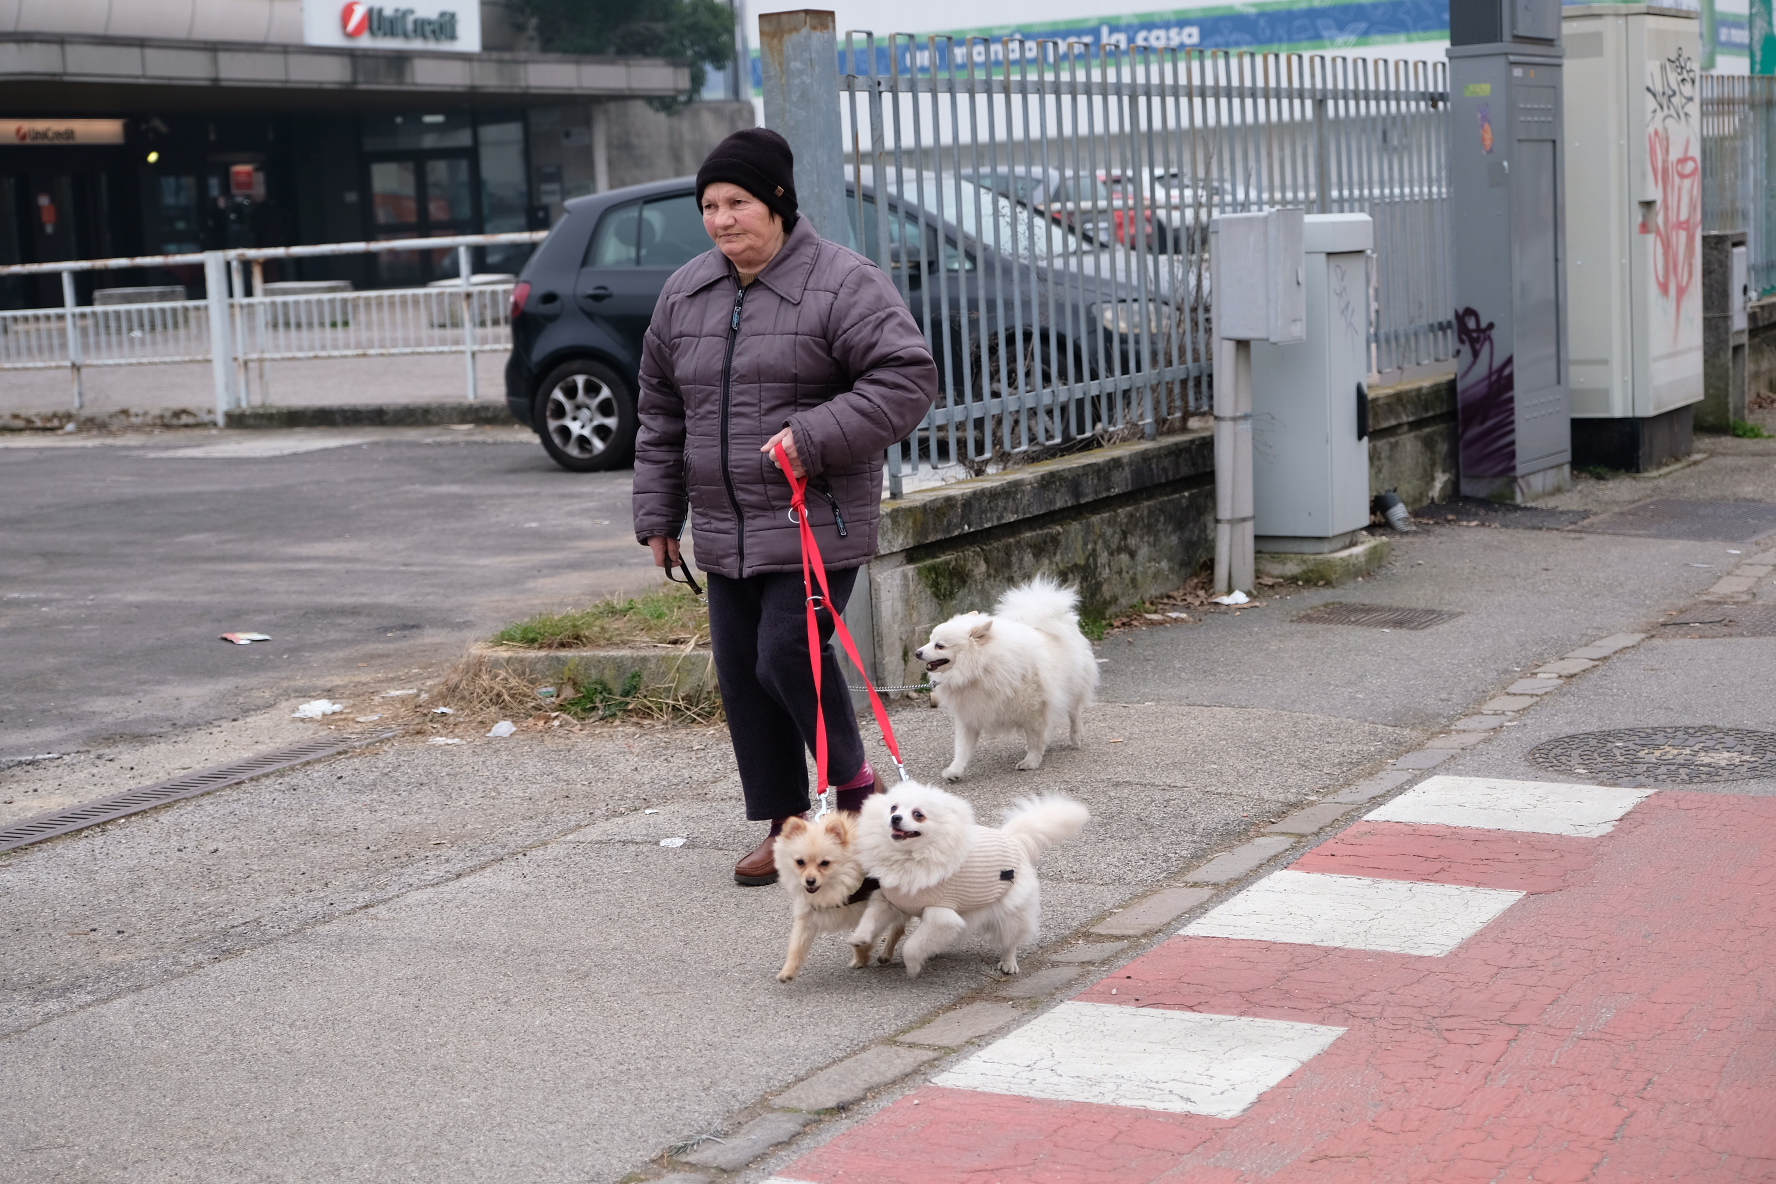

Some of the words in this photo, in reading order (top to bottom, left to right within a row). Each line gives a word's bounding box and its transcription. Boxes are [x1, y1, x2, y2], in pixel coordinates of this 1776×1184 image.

[369, 6, 458, 41] UniCredit
[1100, 24, 1128, 51] la
[1135, 25, 1200, 48] casa
[28, 127, 76, 141] UniCredit
